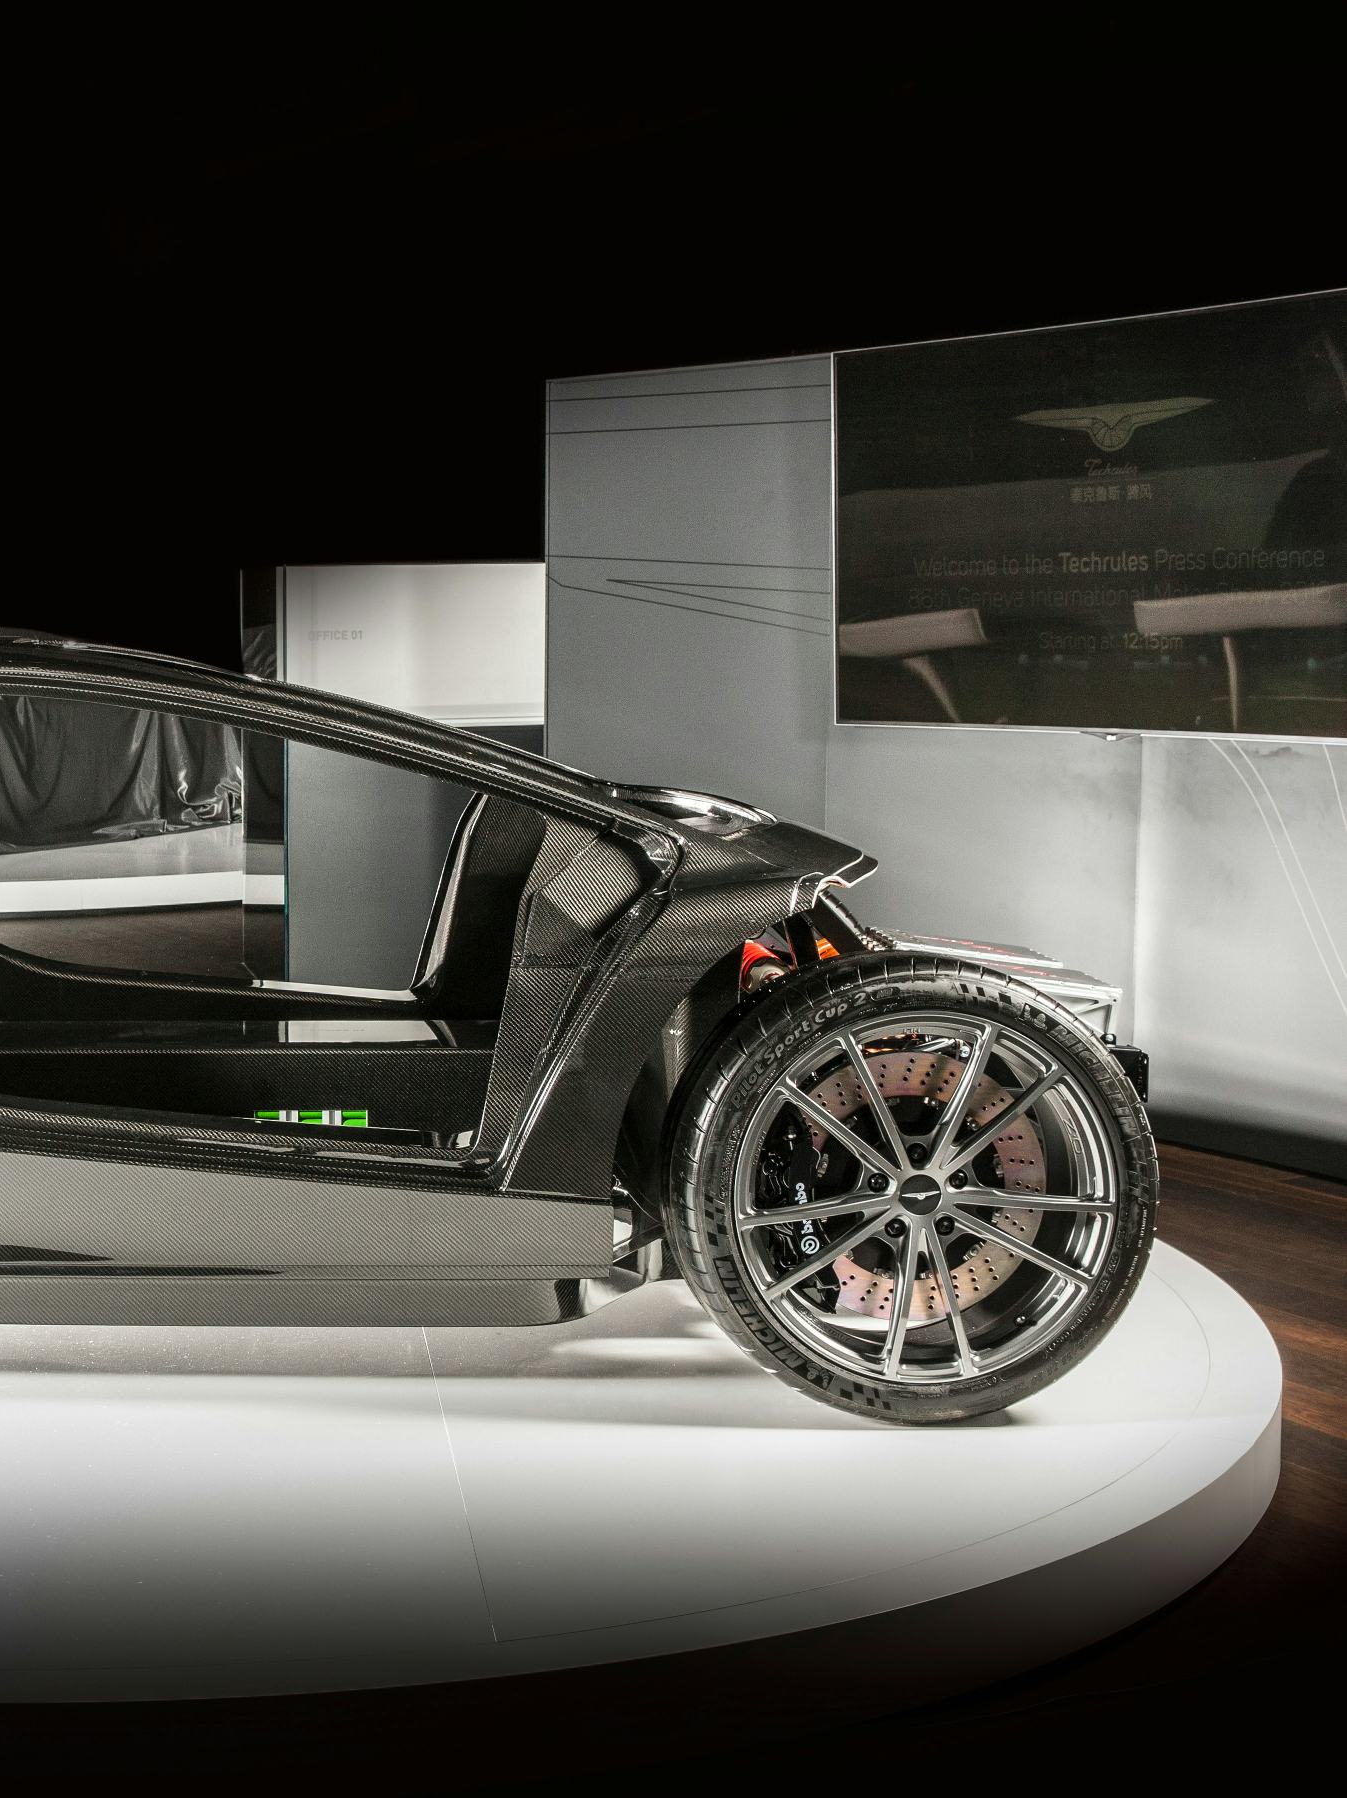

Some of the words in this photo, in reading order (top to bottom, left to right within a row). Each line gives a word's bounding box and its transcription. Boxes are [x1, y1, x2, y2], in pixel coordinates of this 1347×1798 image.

[913, 556, 997, 577] Welcome
[1003, 554, 1019, 576] to
[1025, 553, 1055, 575] the
[1058, 550, 1149, 574] Techrules
[1154, 548, 1206, 572] Press
[1212, 546, 1325, 570] Conference
[957, 586, 1024, 609] Geneva
[1029, 582, 1146, 608] International
[308, 630, 349, 641] OFFICE
[351, 630, 363, 641] 01
[731, 1061, 766, 1109] Pilot
[764, 1021, 811, 1065] Sport
[814, 1002, 848, 1023] Cup
[854, 992, 867, 1006] 2
[1050, 1024, 1141, 1139] MICHELIN
[715, 1258, 804, 1369] MICHELIN
